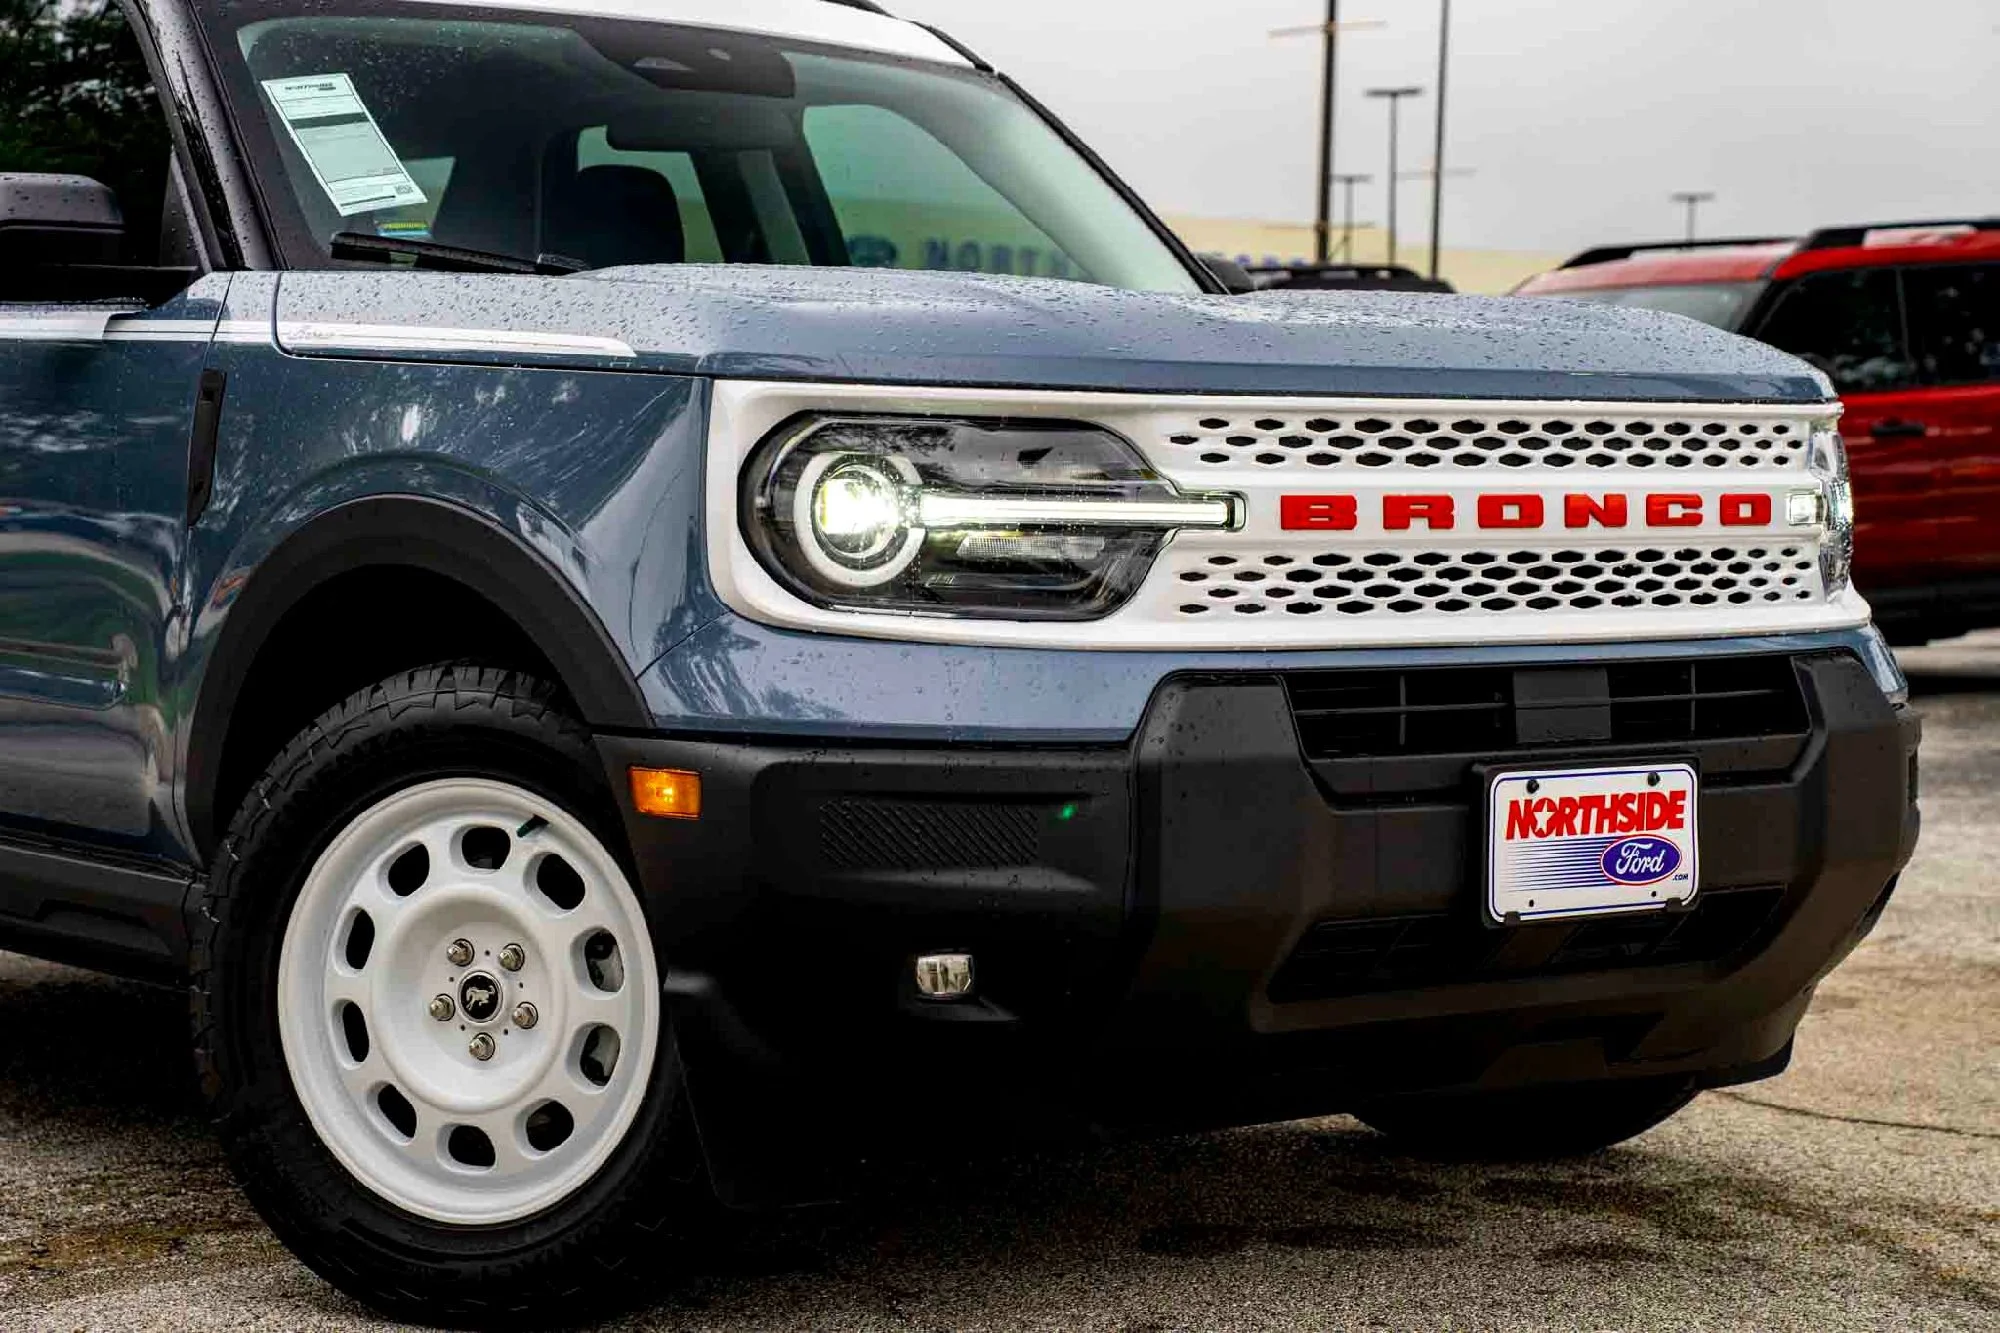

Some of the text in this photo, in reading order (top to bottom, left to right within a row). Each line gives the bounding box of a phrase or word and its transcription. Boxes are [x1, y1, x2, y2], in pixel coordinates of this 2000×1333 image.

[1281, 494, 1772, 530] BRONCO
[1506, 790, 1687, 841] NORTHSIDE
[1616, 843, 1666, 875] Ford
